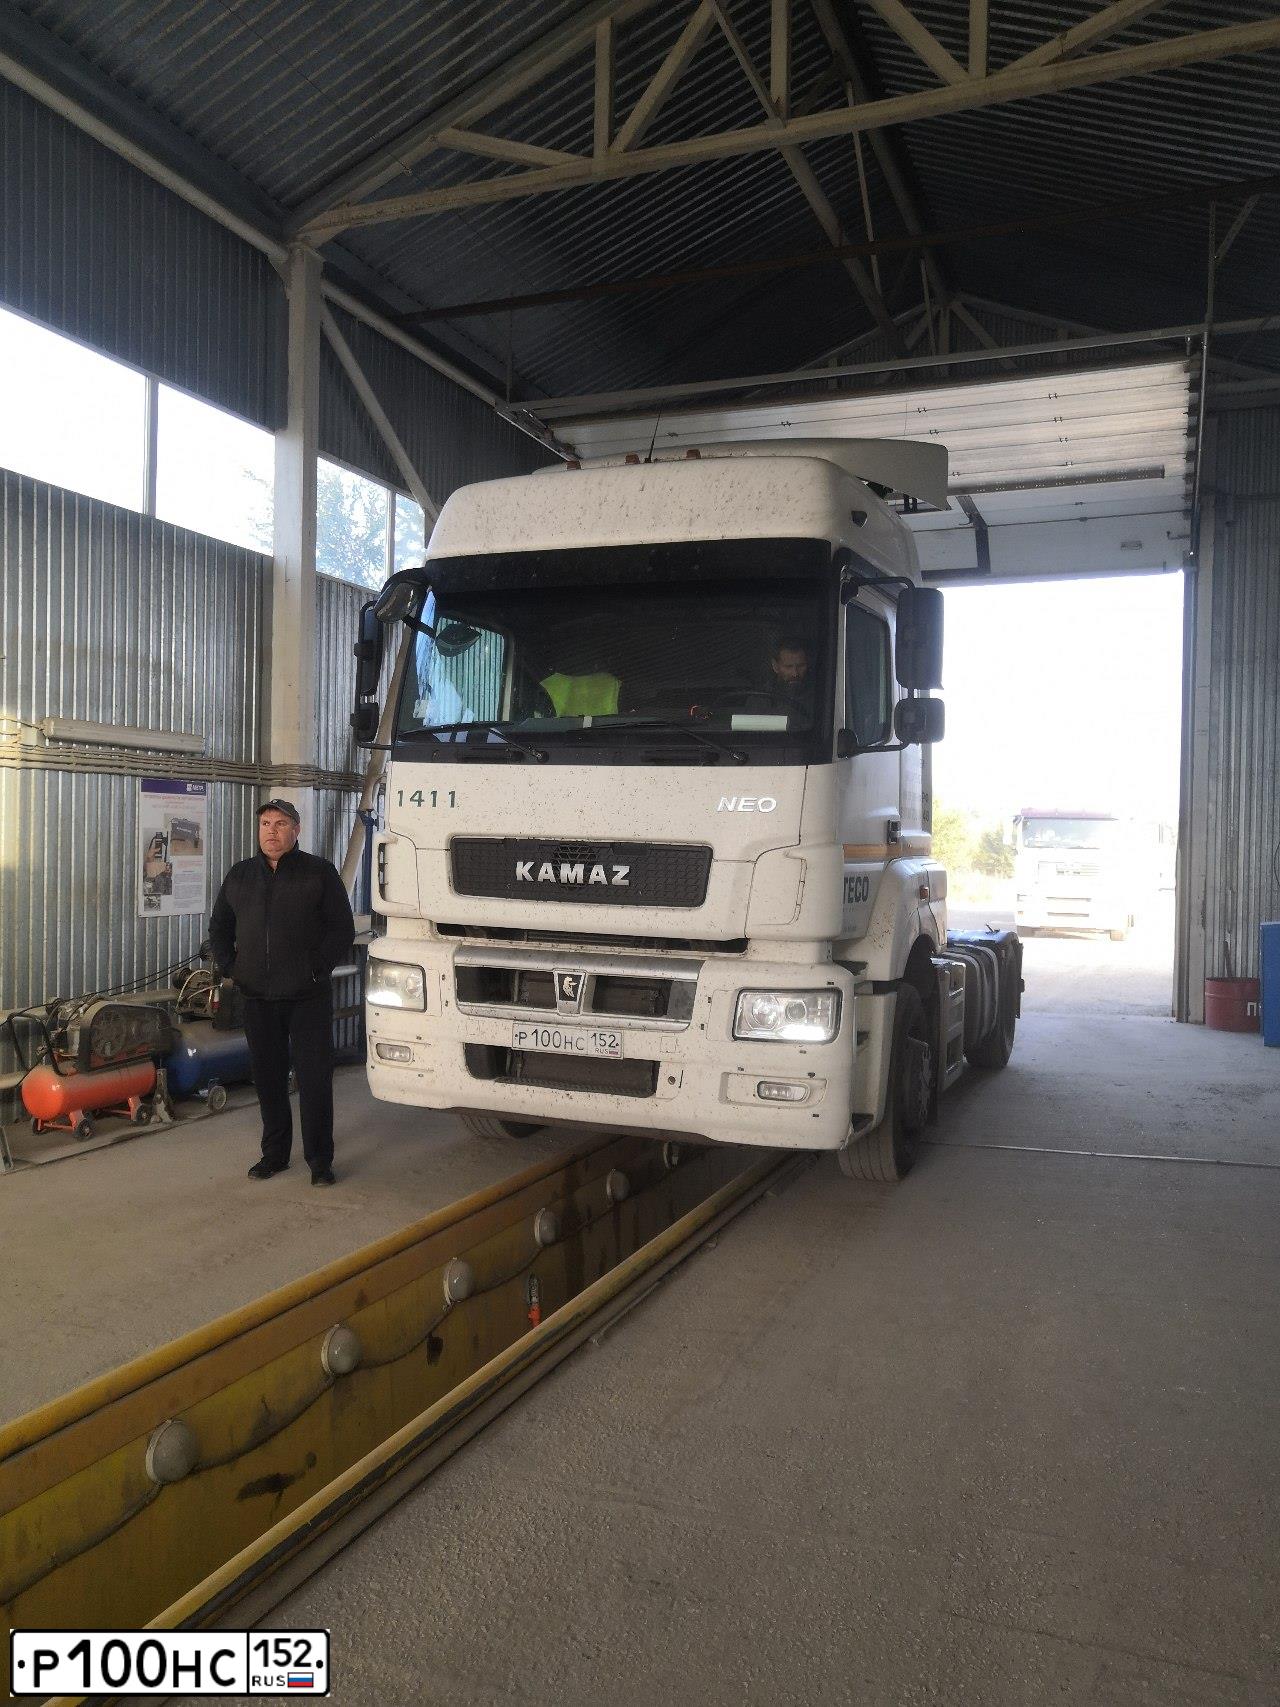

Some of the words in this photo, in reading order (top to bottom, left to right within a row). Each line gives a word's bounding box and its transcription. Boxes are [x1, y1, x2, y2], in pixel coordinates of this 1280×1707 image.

[397, 789, 456, 808] 1411
[716, 796, 777, 813] NEO
[515, 861, 631, 886] KAMAZ
[590, 1032, 617, 1049] 152
[594, 1047, 609, 1055] RUS
